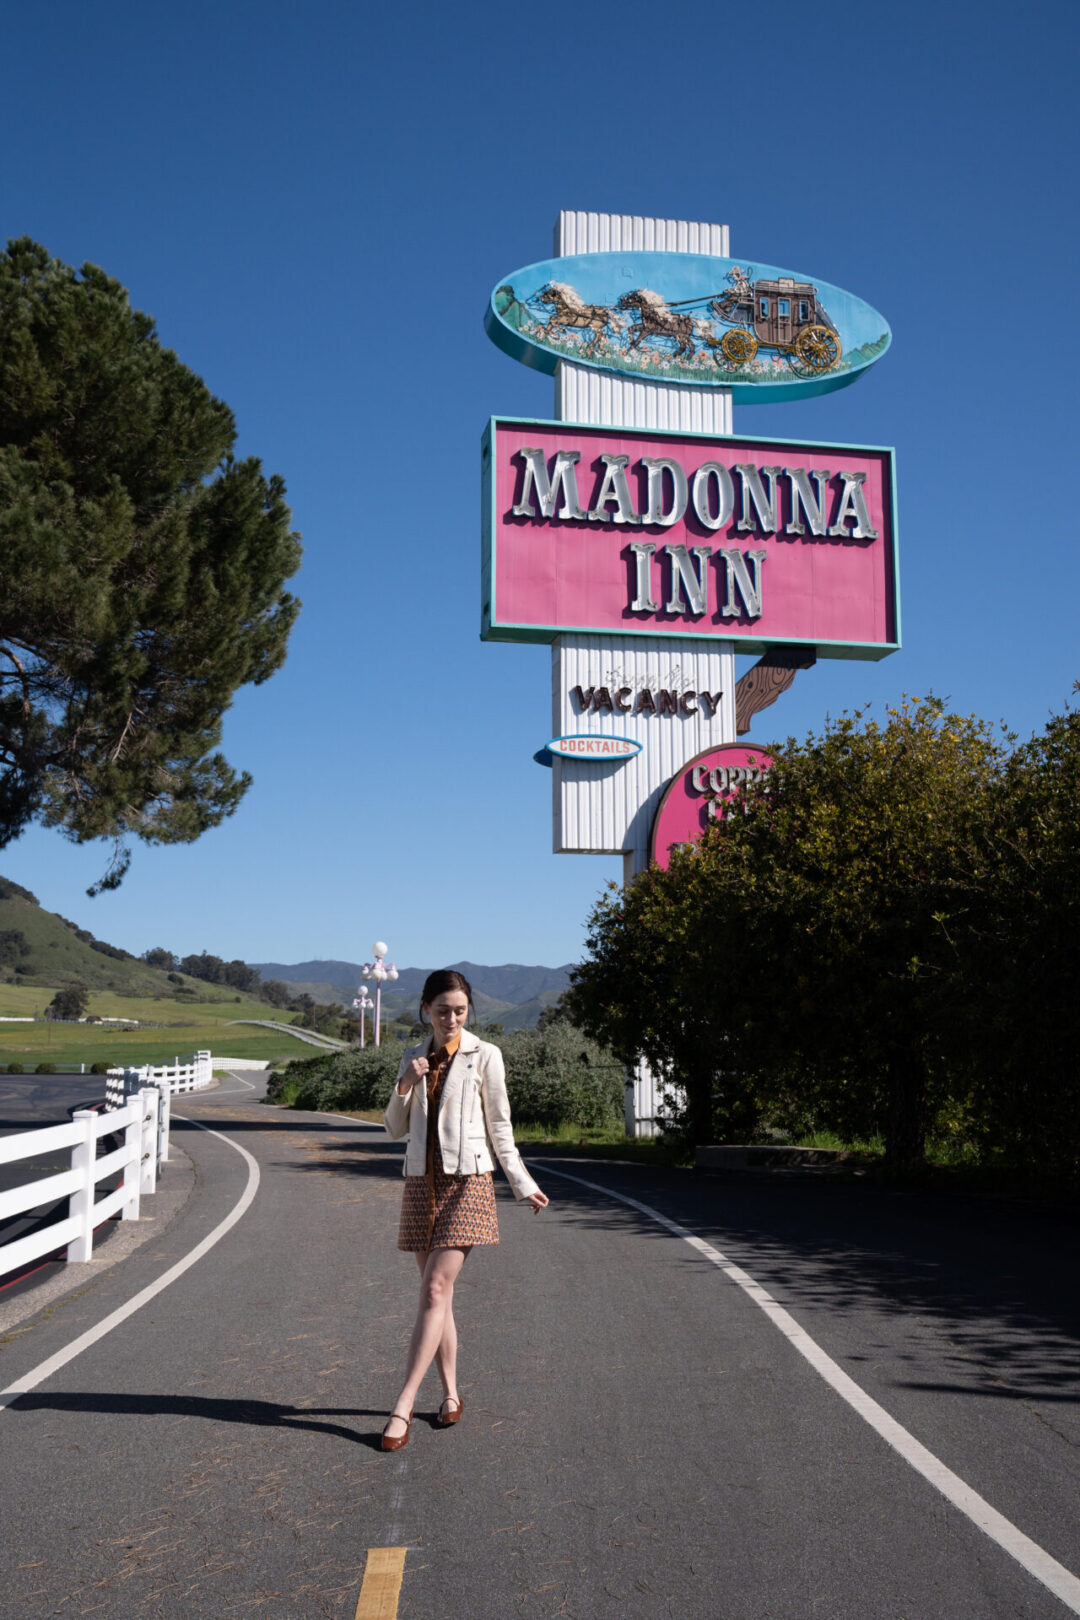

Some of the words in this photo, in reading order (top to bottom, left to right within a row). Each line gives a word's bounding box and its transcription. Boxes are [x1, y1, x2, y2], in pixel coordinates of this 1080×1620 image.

[512, 447, 879, 539] MADONNA
[630, 542, 767, 619] INN
[575, 685, 723, 717] VACANCY
[559, 739, 630, 753] COCKTAILS
